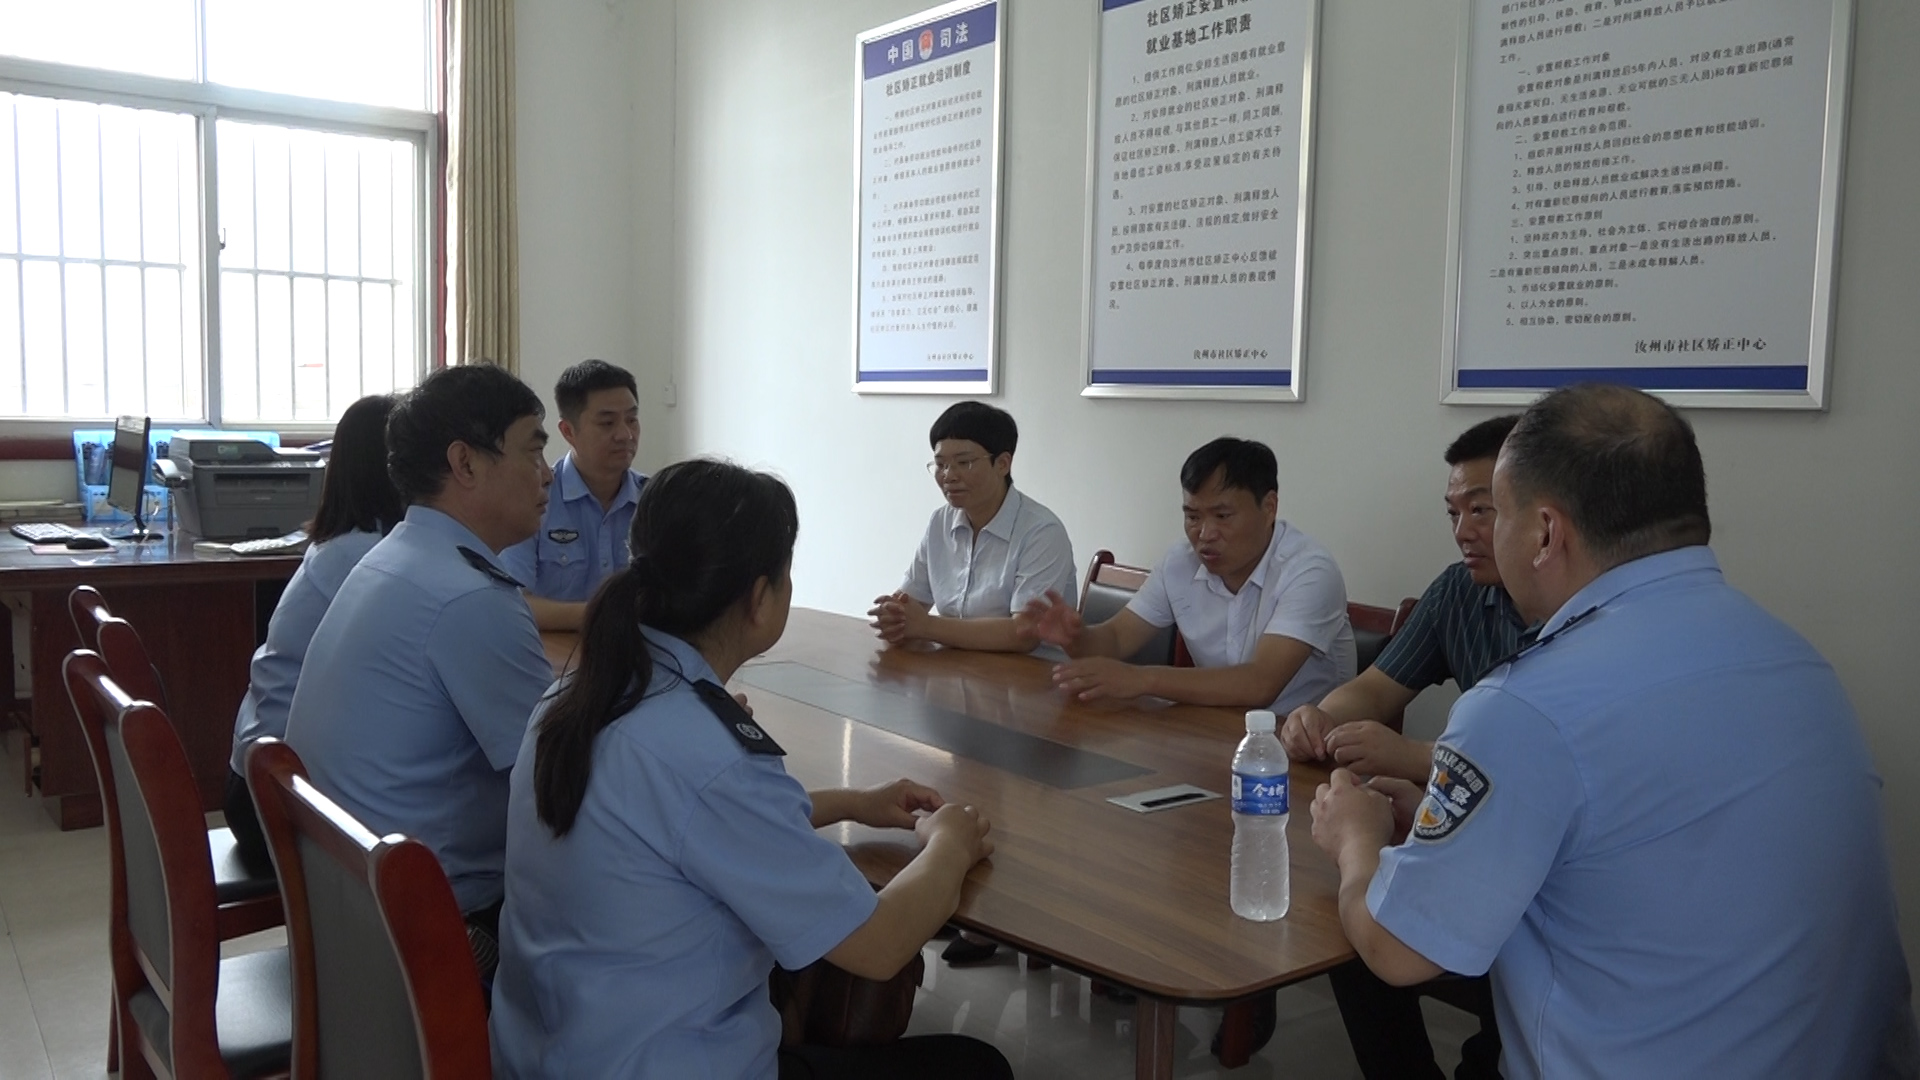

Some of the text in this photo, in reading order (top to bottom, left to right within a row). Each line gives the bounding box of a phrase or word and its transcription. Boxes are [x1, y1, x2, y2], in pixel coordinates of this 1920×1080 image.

[887, 22, 969, 65] 中国 司法
[1145, 13, 1251, 55] 就业基地工作职责
[885, 59, 970, 97] 社区矫正就业培训制度
[1517, 51, 1610, 75] 一、安置帮教工作对象
[1193, 347, 1268, 359] 汝州市社区矫正中心
[1634, 337, 1766, 353] 汝州市社区矫正中心
